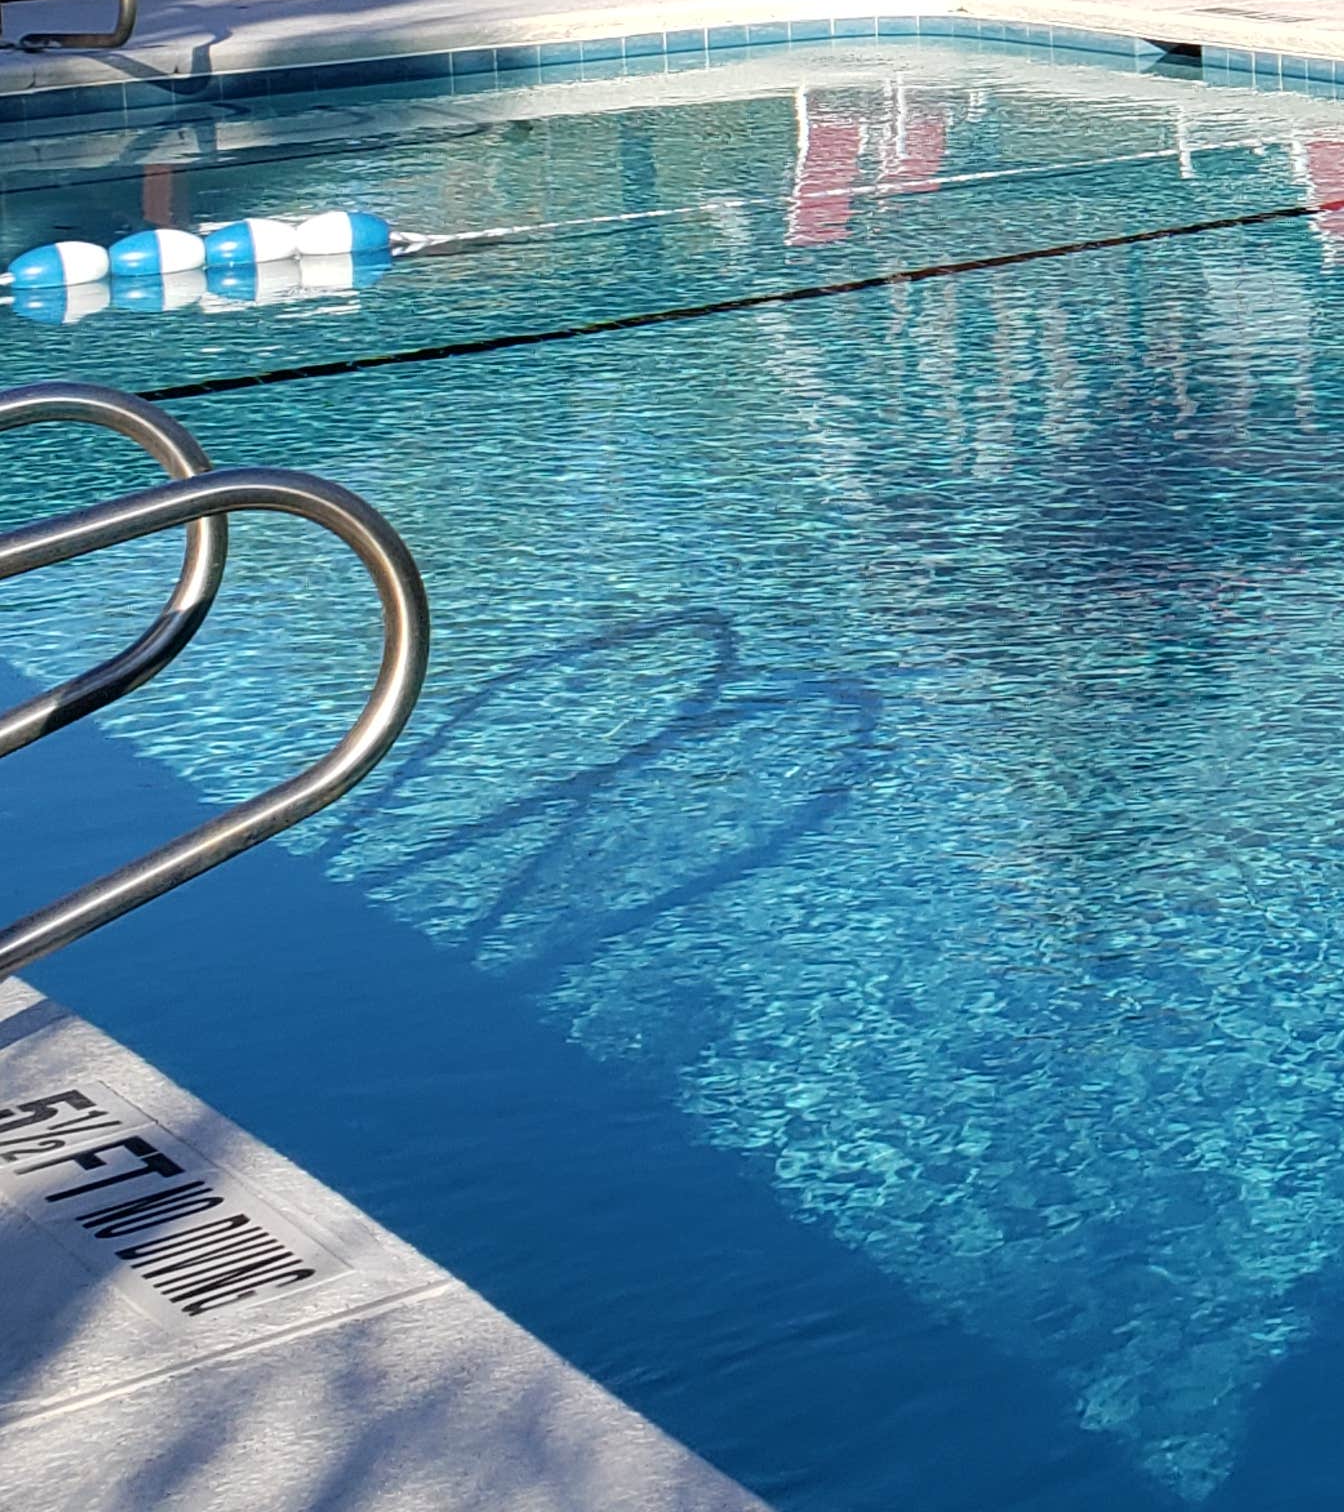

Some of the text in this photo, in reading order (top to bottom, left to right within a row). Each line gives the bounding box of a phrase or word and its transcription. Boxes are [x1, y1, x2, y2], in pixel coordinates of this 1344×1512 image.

[14, 1135, 186, 1203] FT
[75, 1180, 225, 1239] NO
[113, 1213, 316, 1317] DIVING
